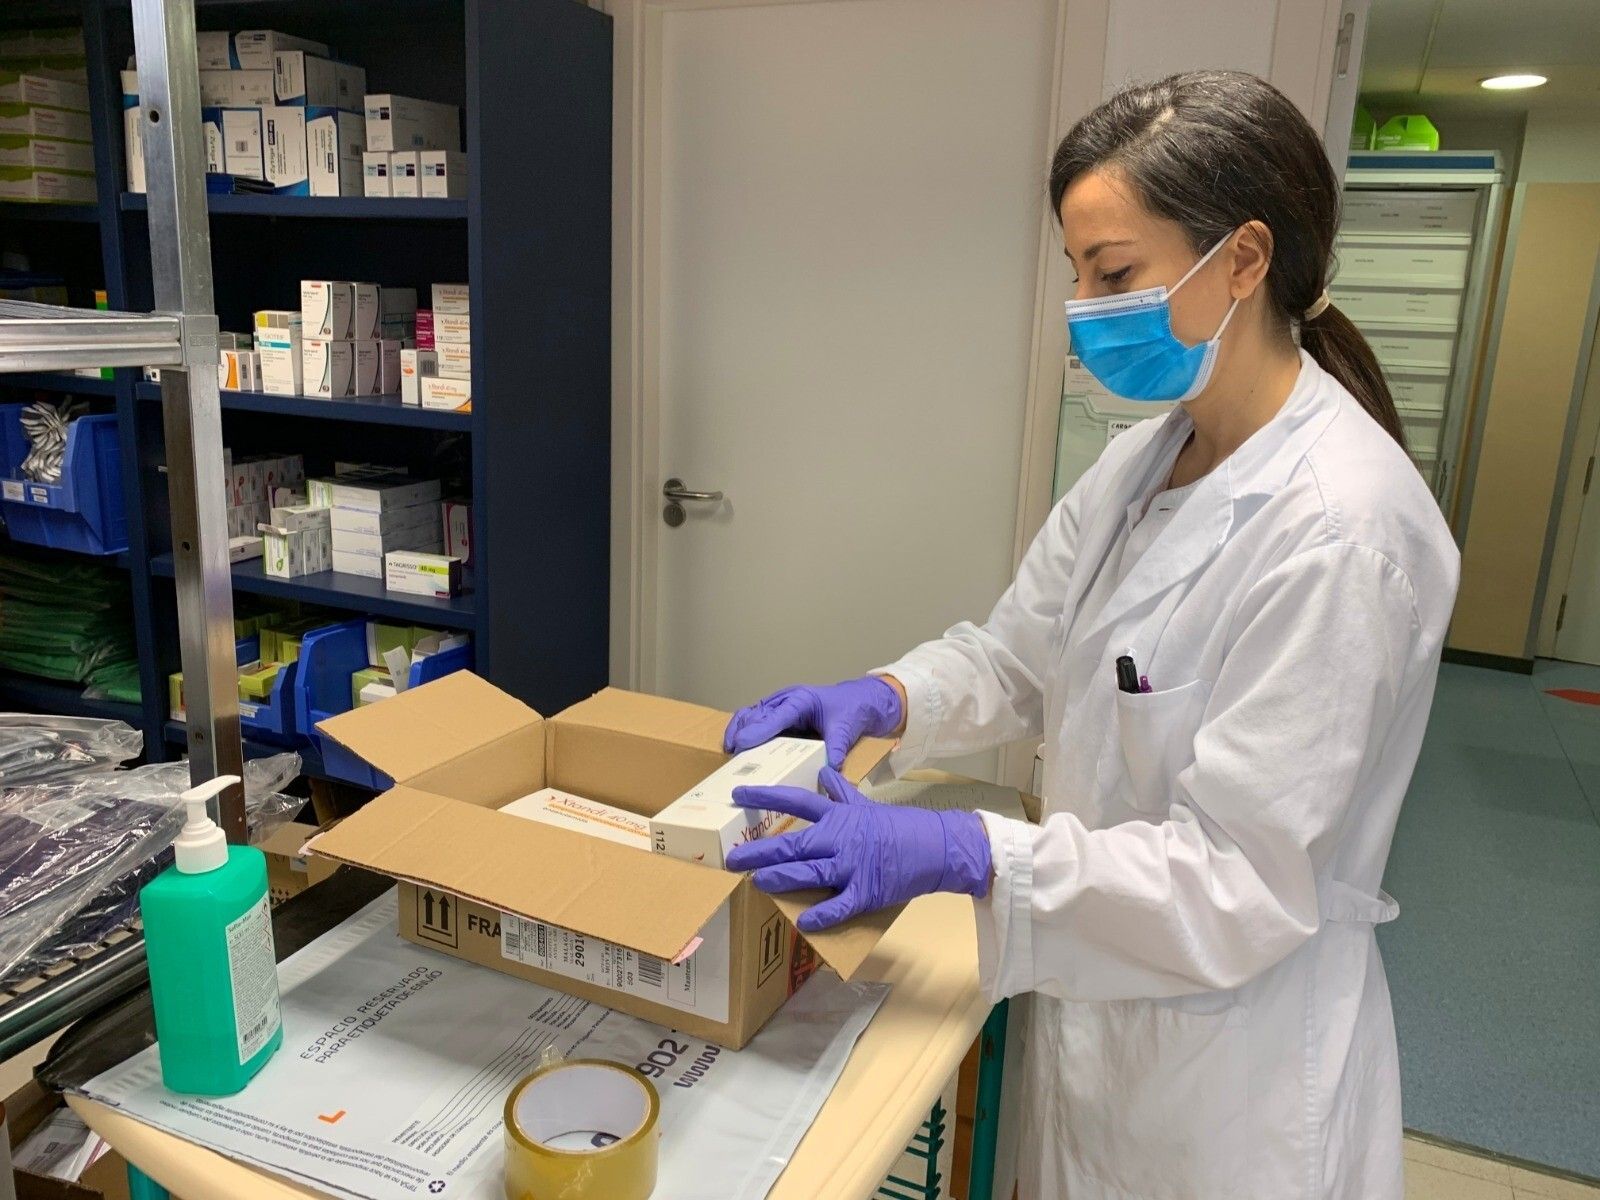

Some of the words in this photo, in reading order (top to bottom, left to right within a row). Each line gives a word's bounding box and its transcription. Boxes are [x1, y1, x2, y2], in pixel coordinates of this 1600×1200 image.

[558, 797, 605, 817] Xtandi
[655, 830, 666, 851] 112
[741, 809, 773, 843] Xtandi
[300, 1015, 357, 1060] ESPACIO
[357, 965, 428, 1014] RESERVADO
[315, 1036, 348, 1064] PARA
[347, 999, 400, 1039] ETIQUETA
[635, 1038, 690, 1078] 902
[400, 1178, 418, 1192] TIPSA
